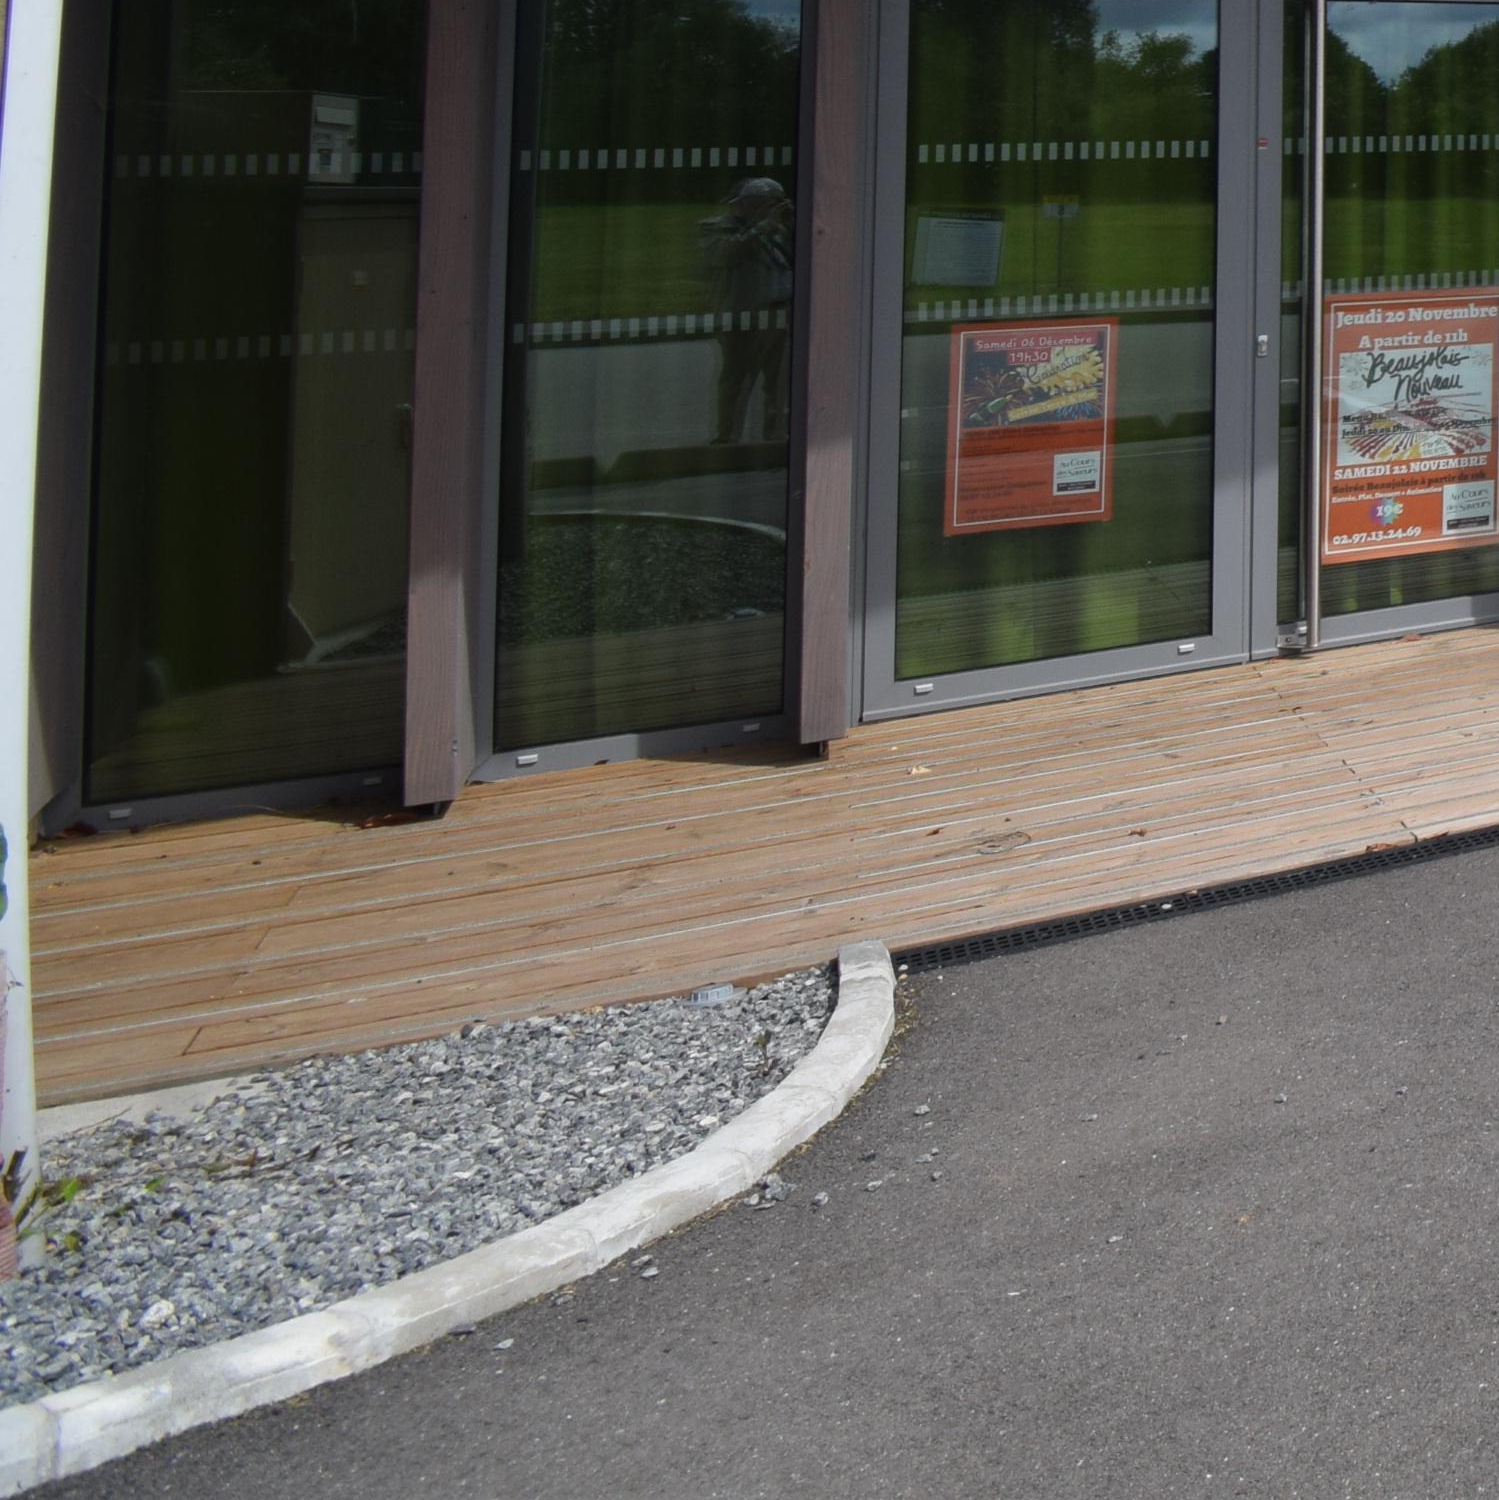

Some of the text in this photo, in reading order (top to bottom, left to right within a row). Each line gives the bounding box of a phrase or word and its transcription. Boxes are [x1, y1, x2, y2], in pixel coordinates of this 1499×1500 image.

[1336, 303, 1498, 329] Jeudi 20 Novembre
[977, 335, 1092, 349] Samedi 06 Décembre
[1358, 328, 1468, 349] A partir de 11h
[1009, 351, 1049, 364] 19h30
[1361, 346, 1470, 388] Beaujolais
[1390, 373, 1463, 403] Nouveau
[1334, 456, 1488, 480] SAMEDI 22 NOVEMBRE
[1332, 481, 1364, 495] Soirée
[1367, 478, 1419, 492] Beaujolais
[1427, 474, 1456, 487] partir
[1458, 472, 1469, 481] de
[1376, 503, 1403, 517] 19€
[1332, 526, 1422, 545] 02.97.13.24.69
